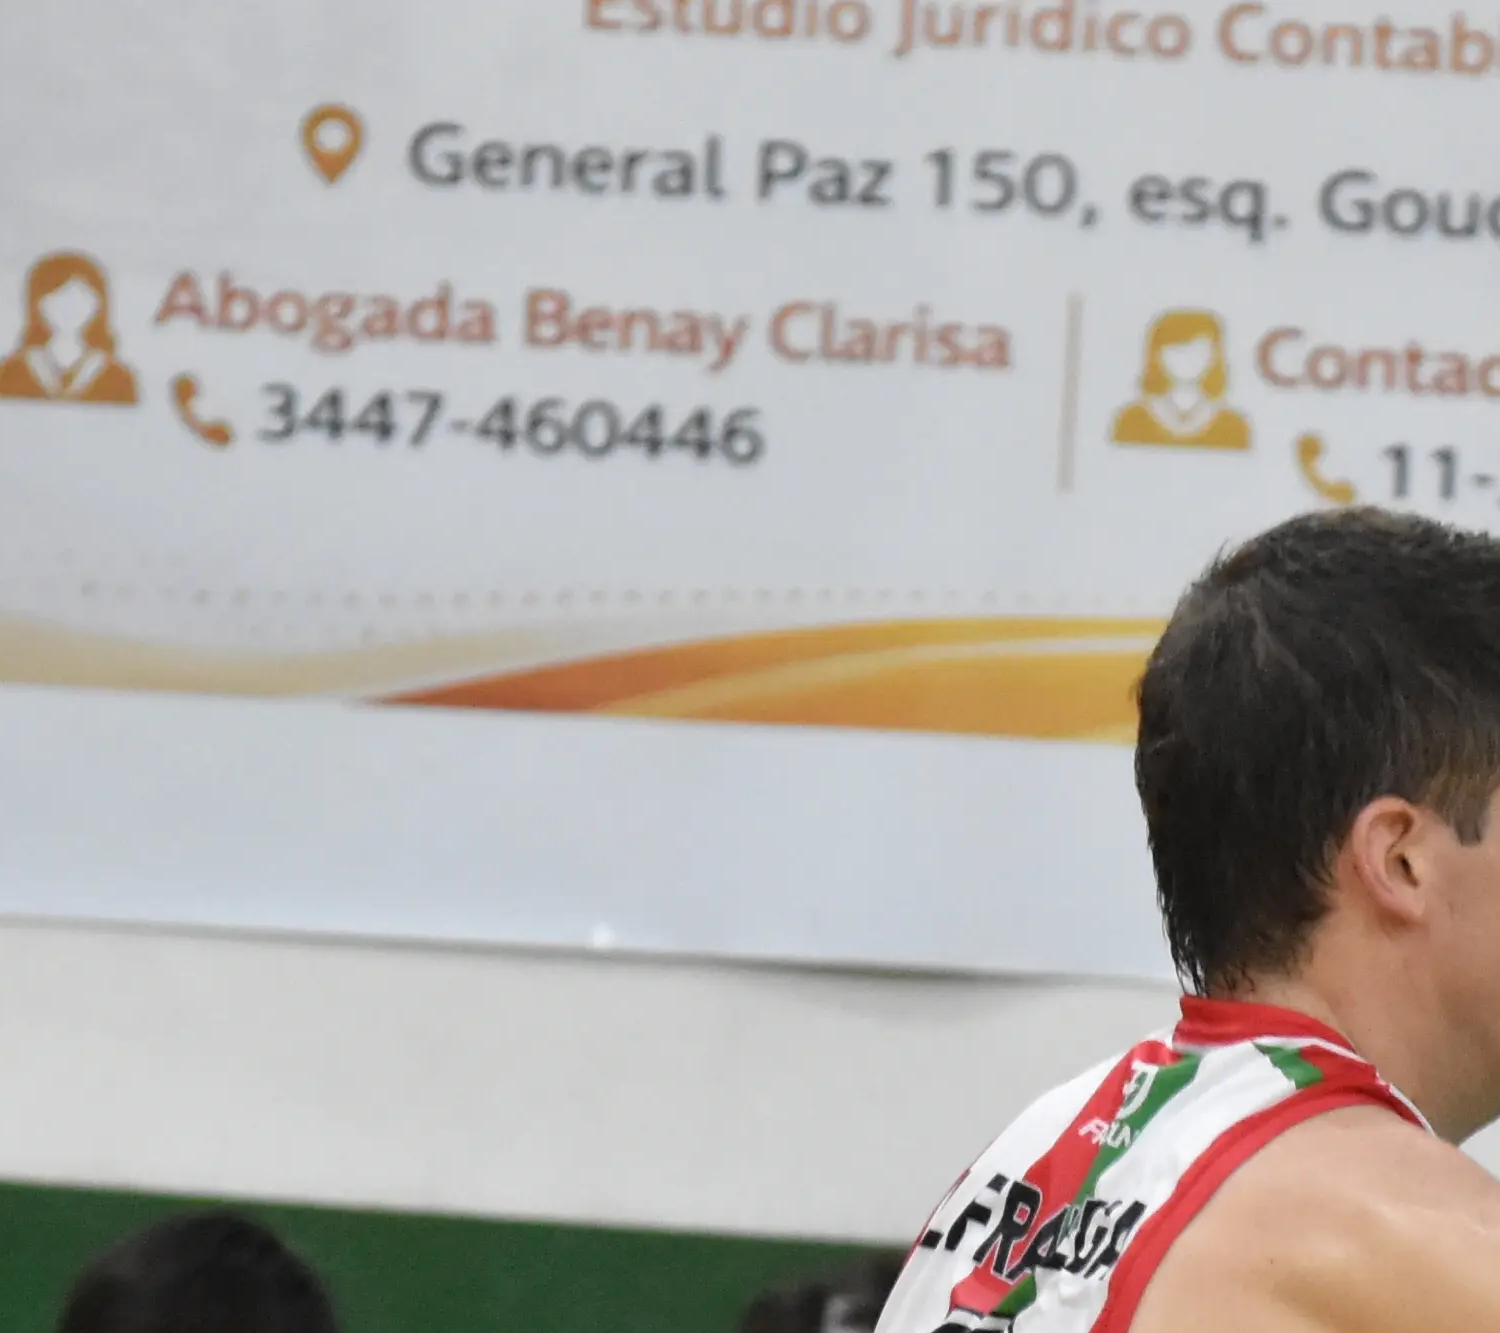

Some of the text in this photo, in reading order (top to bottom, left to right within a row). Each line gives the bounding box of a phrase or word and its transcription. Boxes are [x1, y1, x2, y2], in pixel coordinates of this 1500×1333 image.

[409, 118, 727, 202] General
[757, 138, 893, 211] Paz
[926, 150, 1100, 227] 150,
[1128, 170, 1288, 245] esq.
[154, 270, 1013, 372] Abogada Benay Clarisa
[257, 382, 767, 468] 3447-460446
